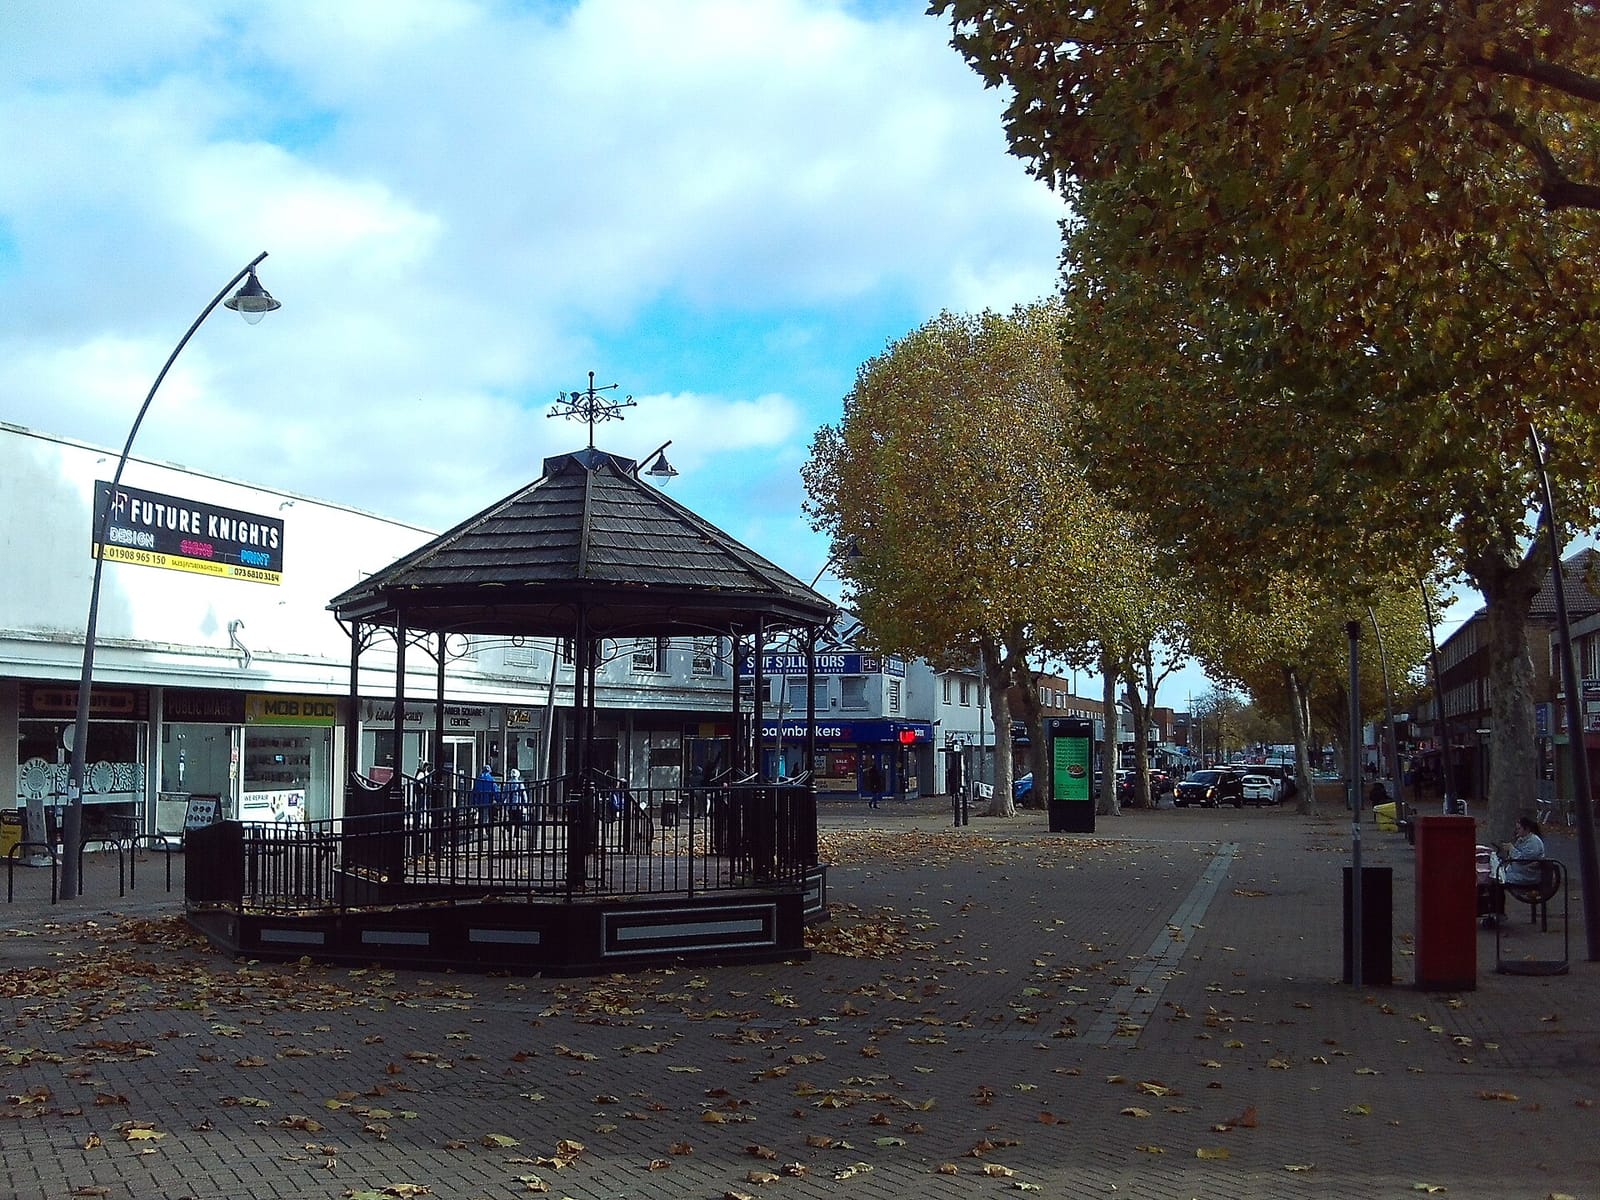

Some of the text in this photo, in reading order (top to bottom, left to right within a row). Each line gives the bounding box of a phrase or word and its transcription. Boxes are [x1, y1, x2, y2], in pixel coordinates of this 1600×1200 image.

[131, 499, 279, 549] FUTURE KNIGHTS
[109, 526, 155, 549] DESIGN
[109, 548, 167, 565] 01908 965 150
[240, 549, 271, 567] PRINT
[747, 656, 844, 669] SF SOLICTORS
[264, 701, 298, 715] MOB
[450, 717, 471, 727] CENTRE
